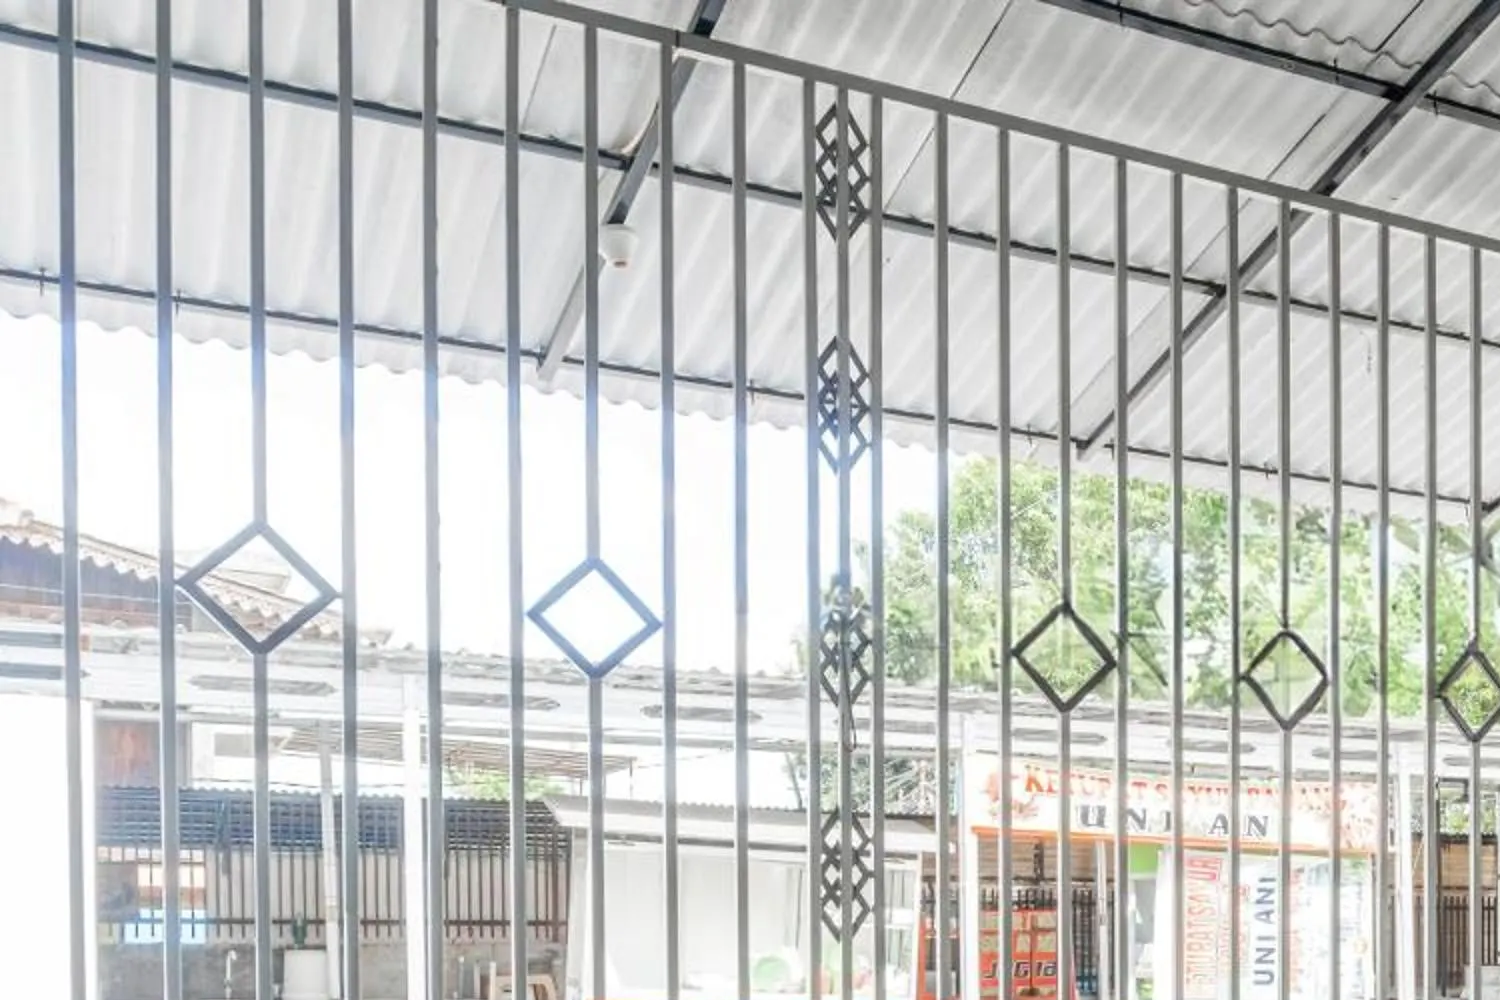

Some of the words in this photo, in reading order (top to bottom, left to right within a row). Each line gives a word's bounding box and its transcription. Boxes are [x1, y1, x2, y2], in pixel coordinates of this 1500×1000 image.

[1208, 811, 1270, 839] AN
[1253, 876, 1276, 924] ANI
[1253, 935, 1276, 986] UNI
